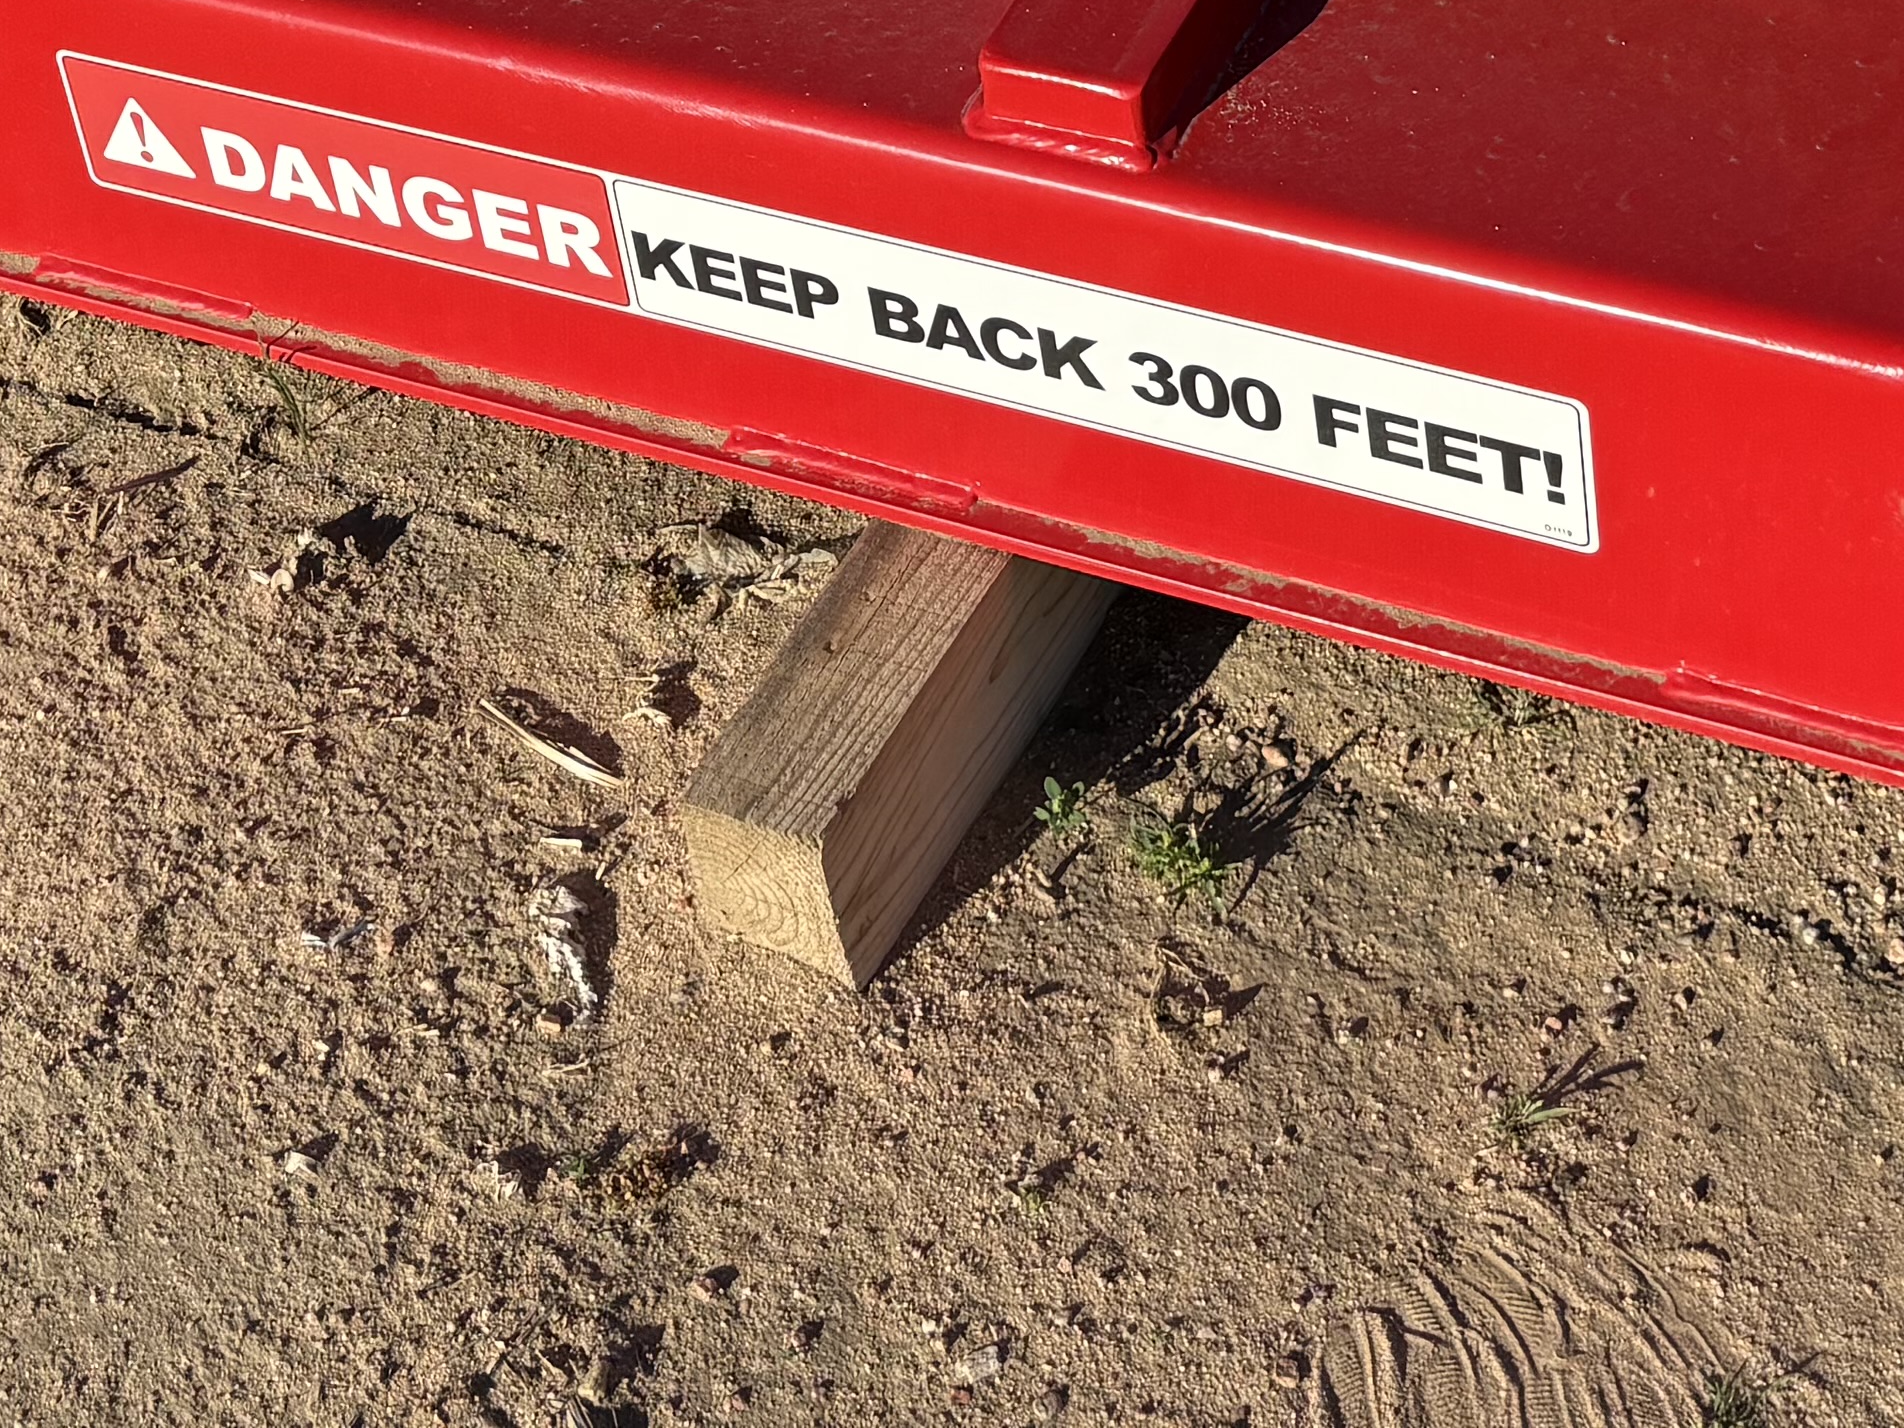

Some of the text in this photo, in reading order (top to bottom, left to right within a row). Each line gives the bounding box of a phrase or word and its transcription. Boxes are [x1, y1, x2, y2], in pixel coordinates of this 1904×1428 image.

[200, 126, 1566, 505] DANGER KEEP BACK 300 FEET!
